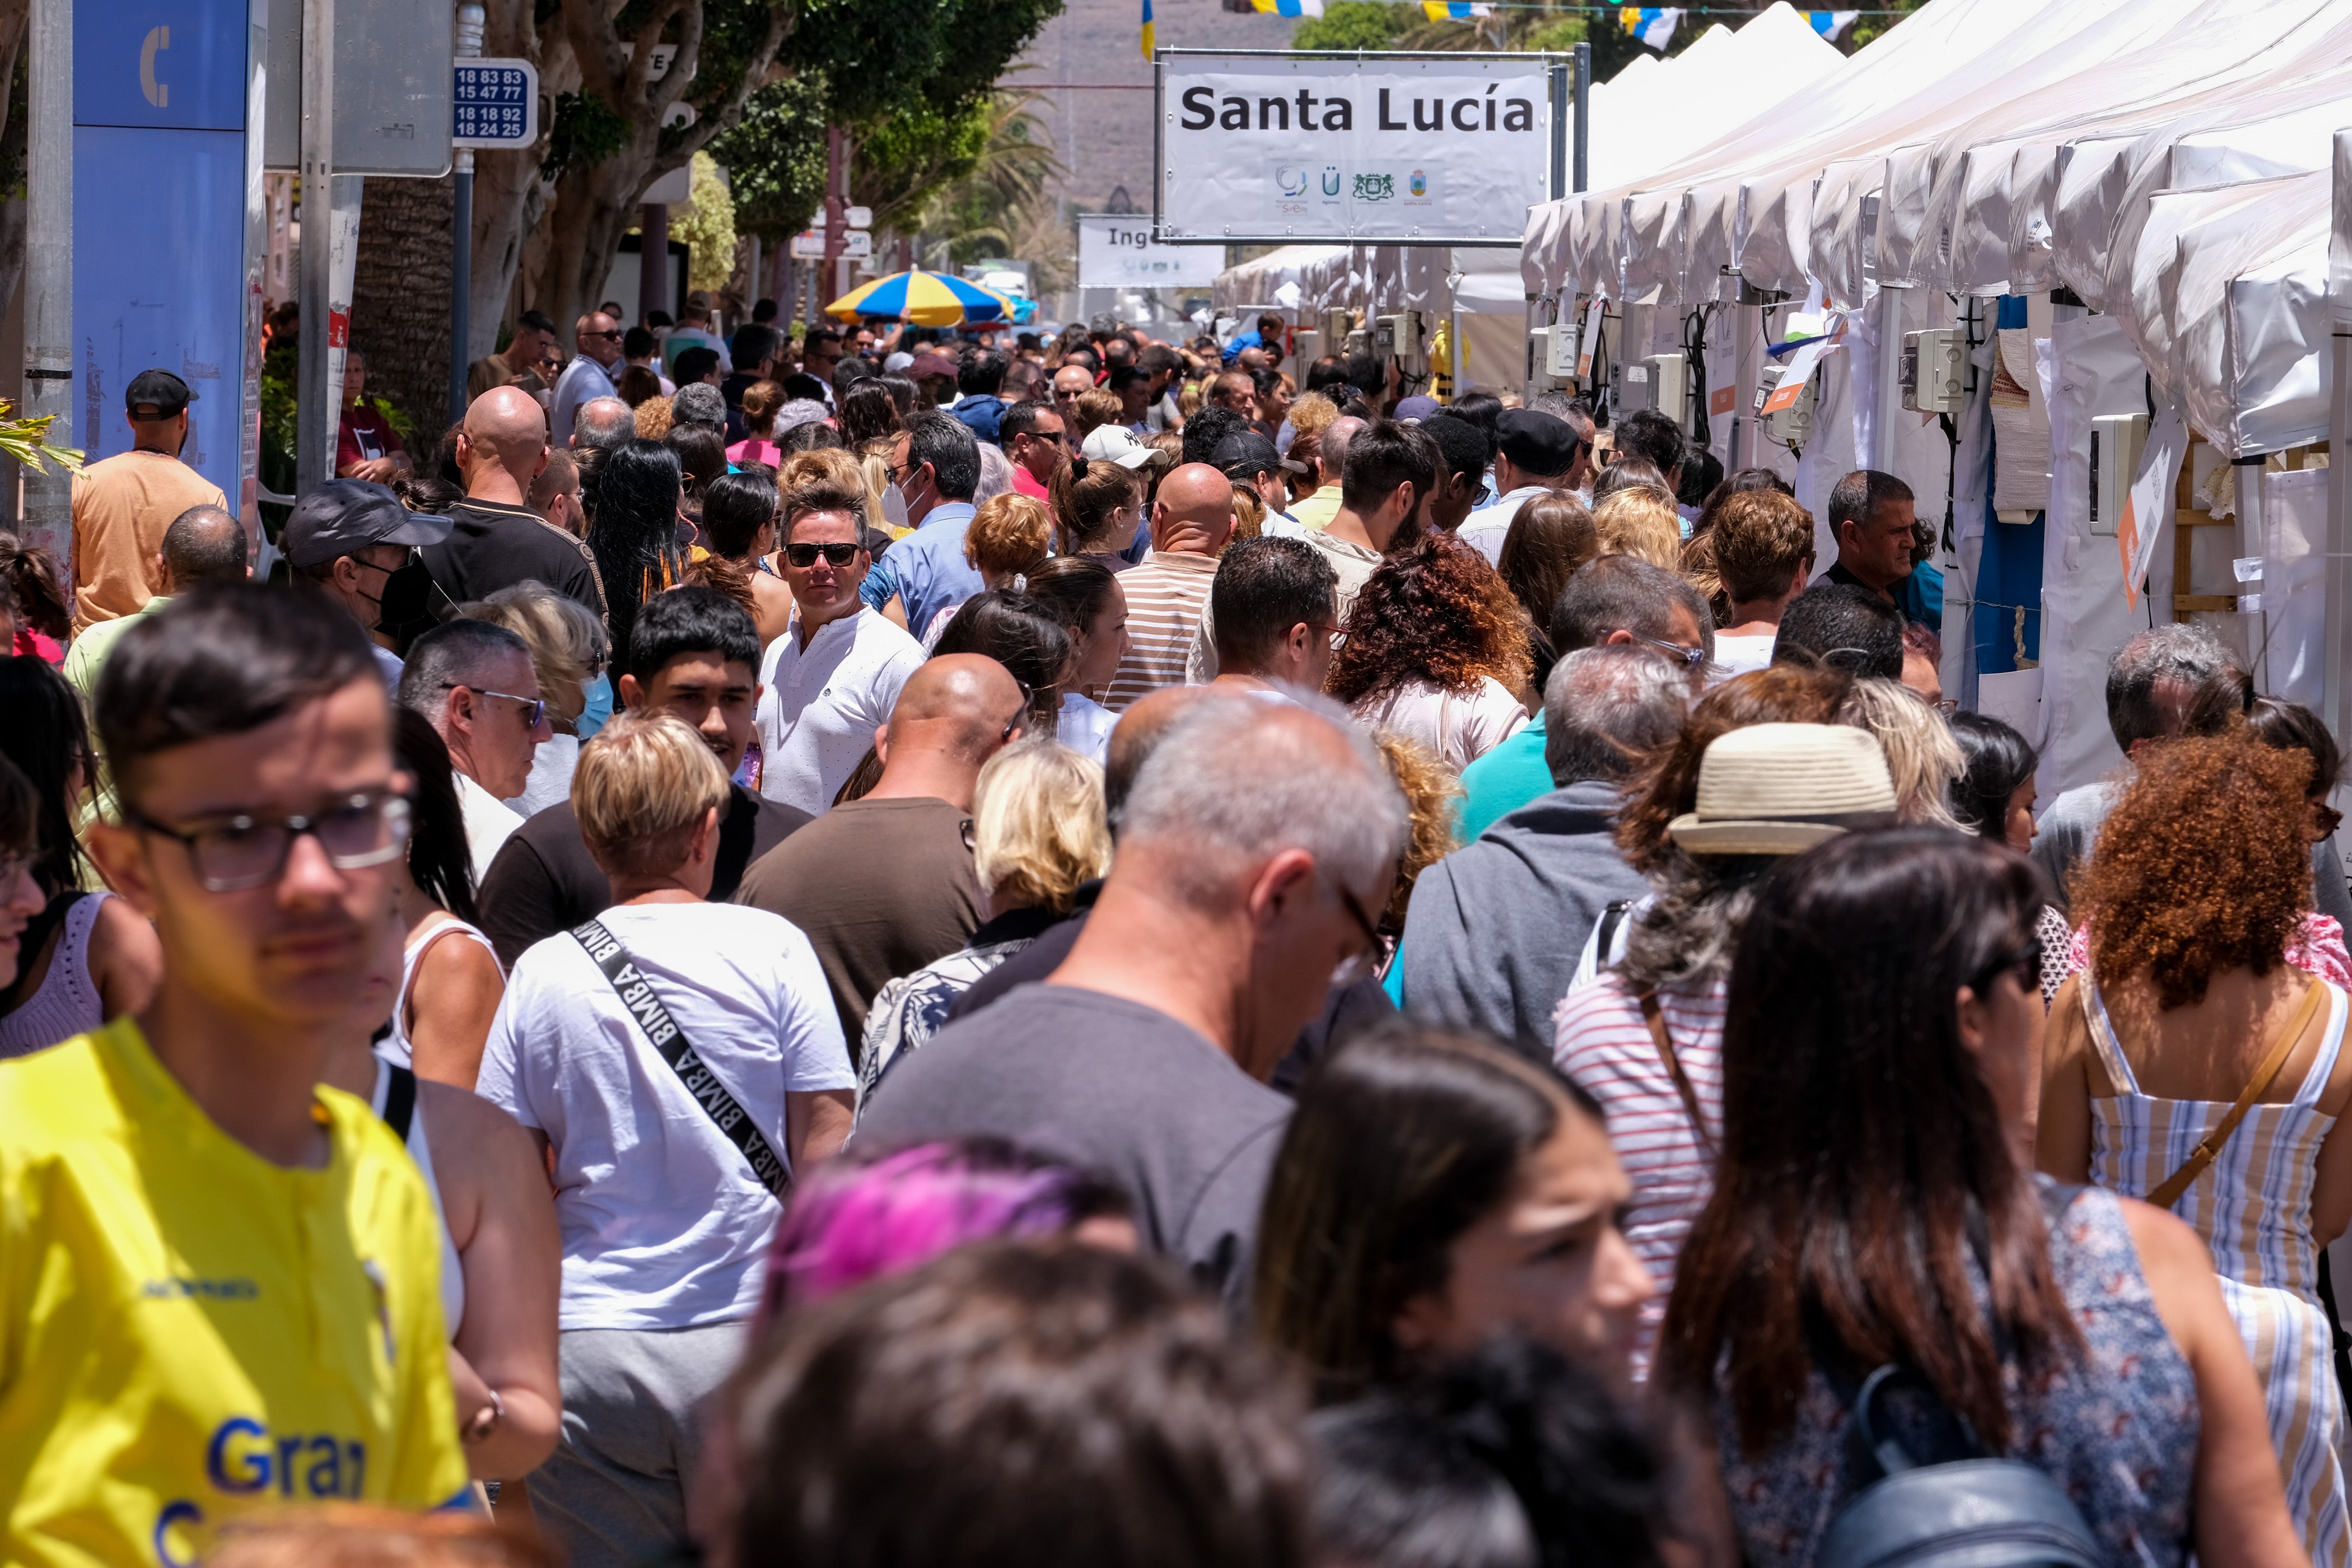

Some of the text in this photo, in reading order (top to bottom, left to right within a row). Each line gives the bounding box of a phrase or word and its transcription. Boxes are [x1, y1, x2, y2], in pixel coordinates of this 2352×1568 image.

[458, 70, 522, 84] 18 83 83
[458, 86, 476, 99] 15
[479, 86, 499, 99] 47
[503, 87, 522, 100] 77
[458, 107, 521, 122] 18 18 92
[1180, 83, 1534, 132] Santa Lucía
[457, 122, 521, 137] 18 24 25
[1109, 228, 1154, 250] Ing
[1124, 431, 1141, 447] NY
[572, 919, 621, 963] BIMB
[613, 962, 678, 1047] BIMBA
[674, 1046, 744, 1132] BIMBA
